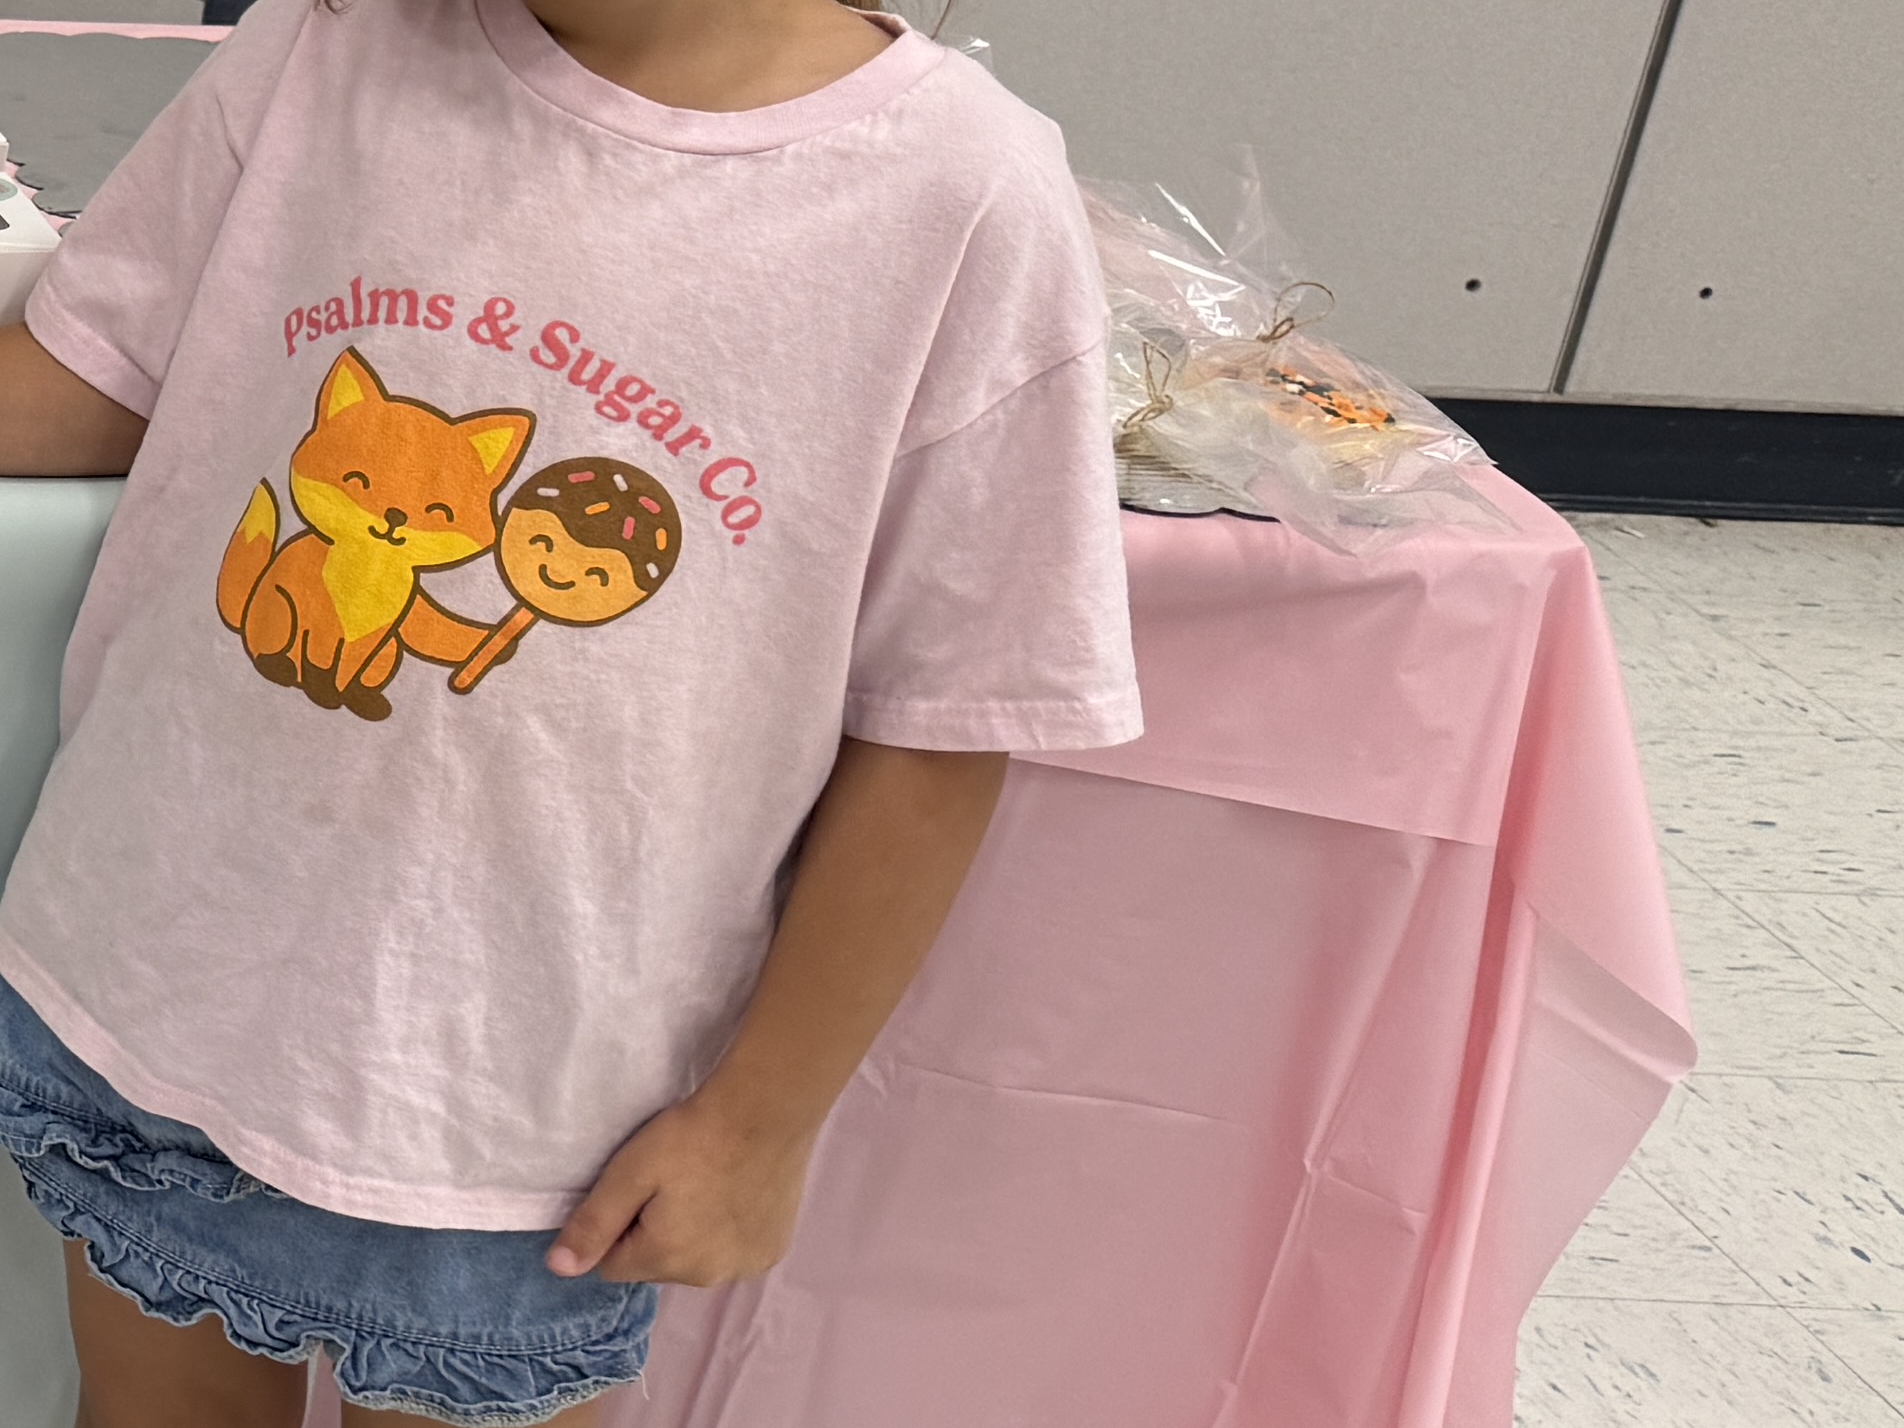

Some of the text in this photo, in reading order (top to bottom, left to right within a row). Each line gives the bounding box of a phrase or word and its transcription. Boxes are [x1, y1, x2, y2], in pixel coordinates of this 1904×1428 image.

[283, 275, 765, 548] Psalms & Sugar Co.
